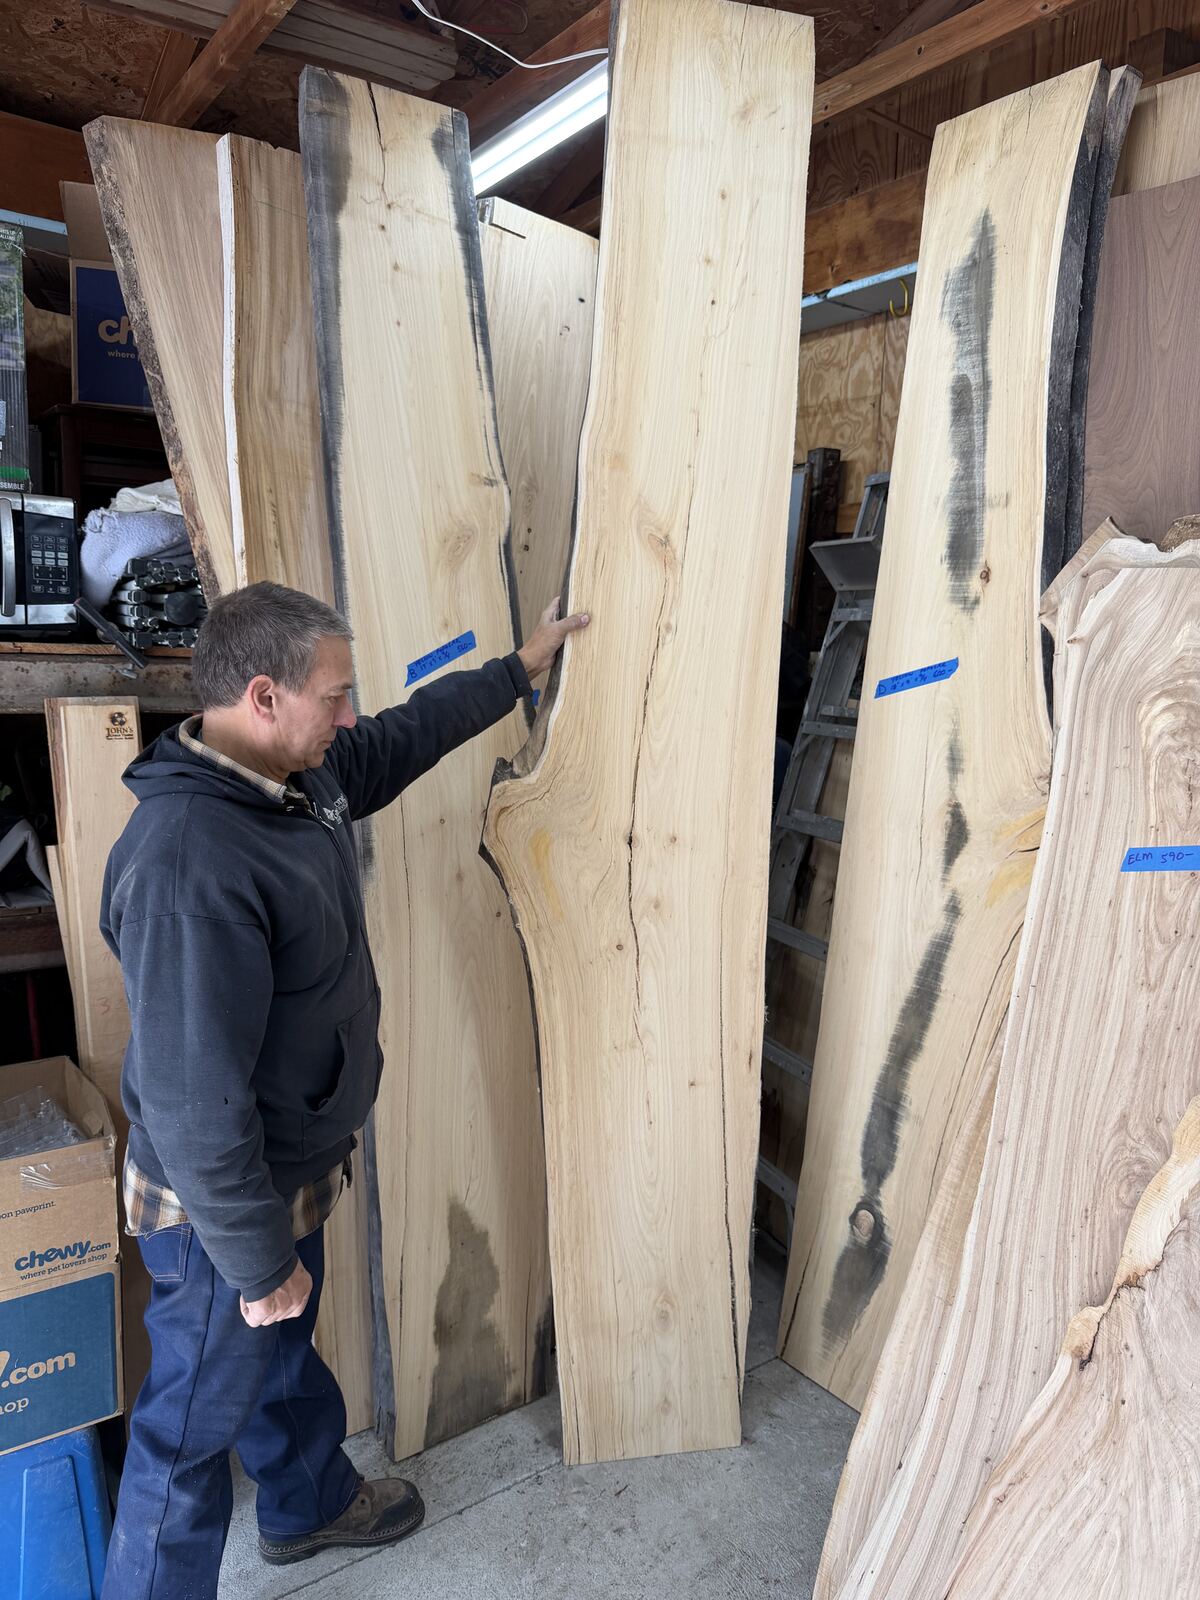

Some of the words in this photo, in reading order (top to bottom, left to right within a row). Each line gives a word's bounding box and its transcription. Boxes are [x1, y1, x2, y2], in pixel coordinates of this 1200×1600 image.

[107, 350, 136, 359] where
[879, 684, 887, 695] D
[1127, 852, 1153, 865] ELM
[0, 1211, 13, 1219] on
[15, 1240, 111, 1271] chewy.com
[20, 1269, 46, 1281] where
[47, 1265, 60, 1275] pet
[62, 1259, 87, 1270] lovers
[88, 1252, 108, 1265] shop
